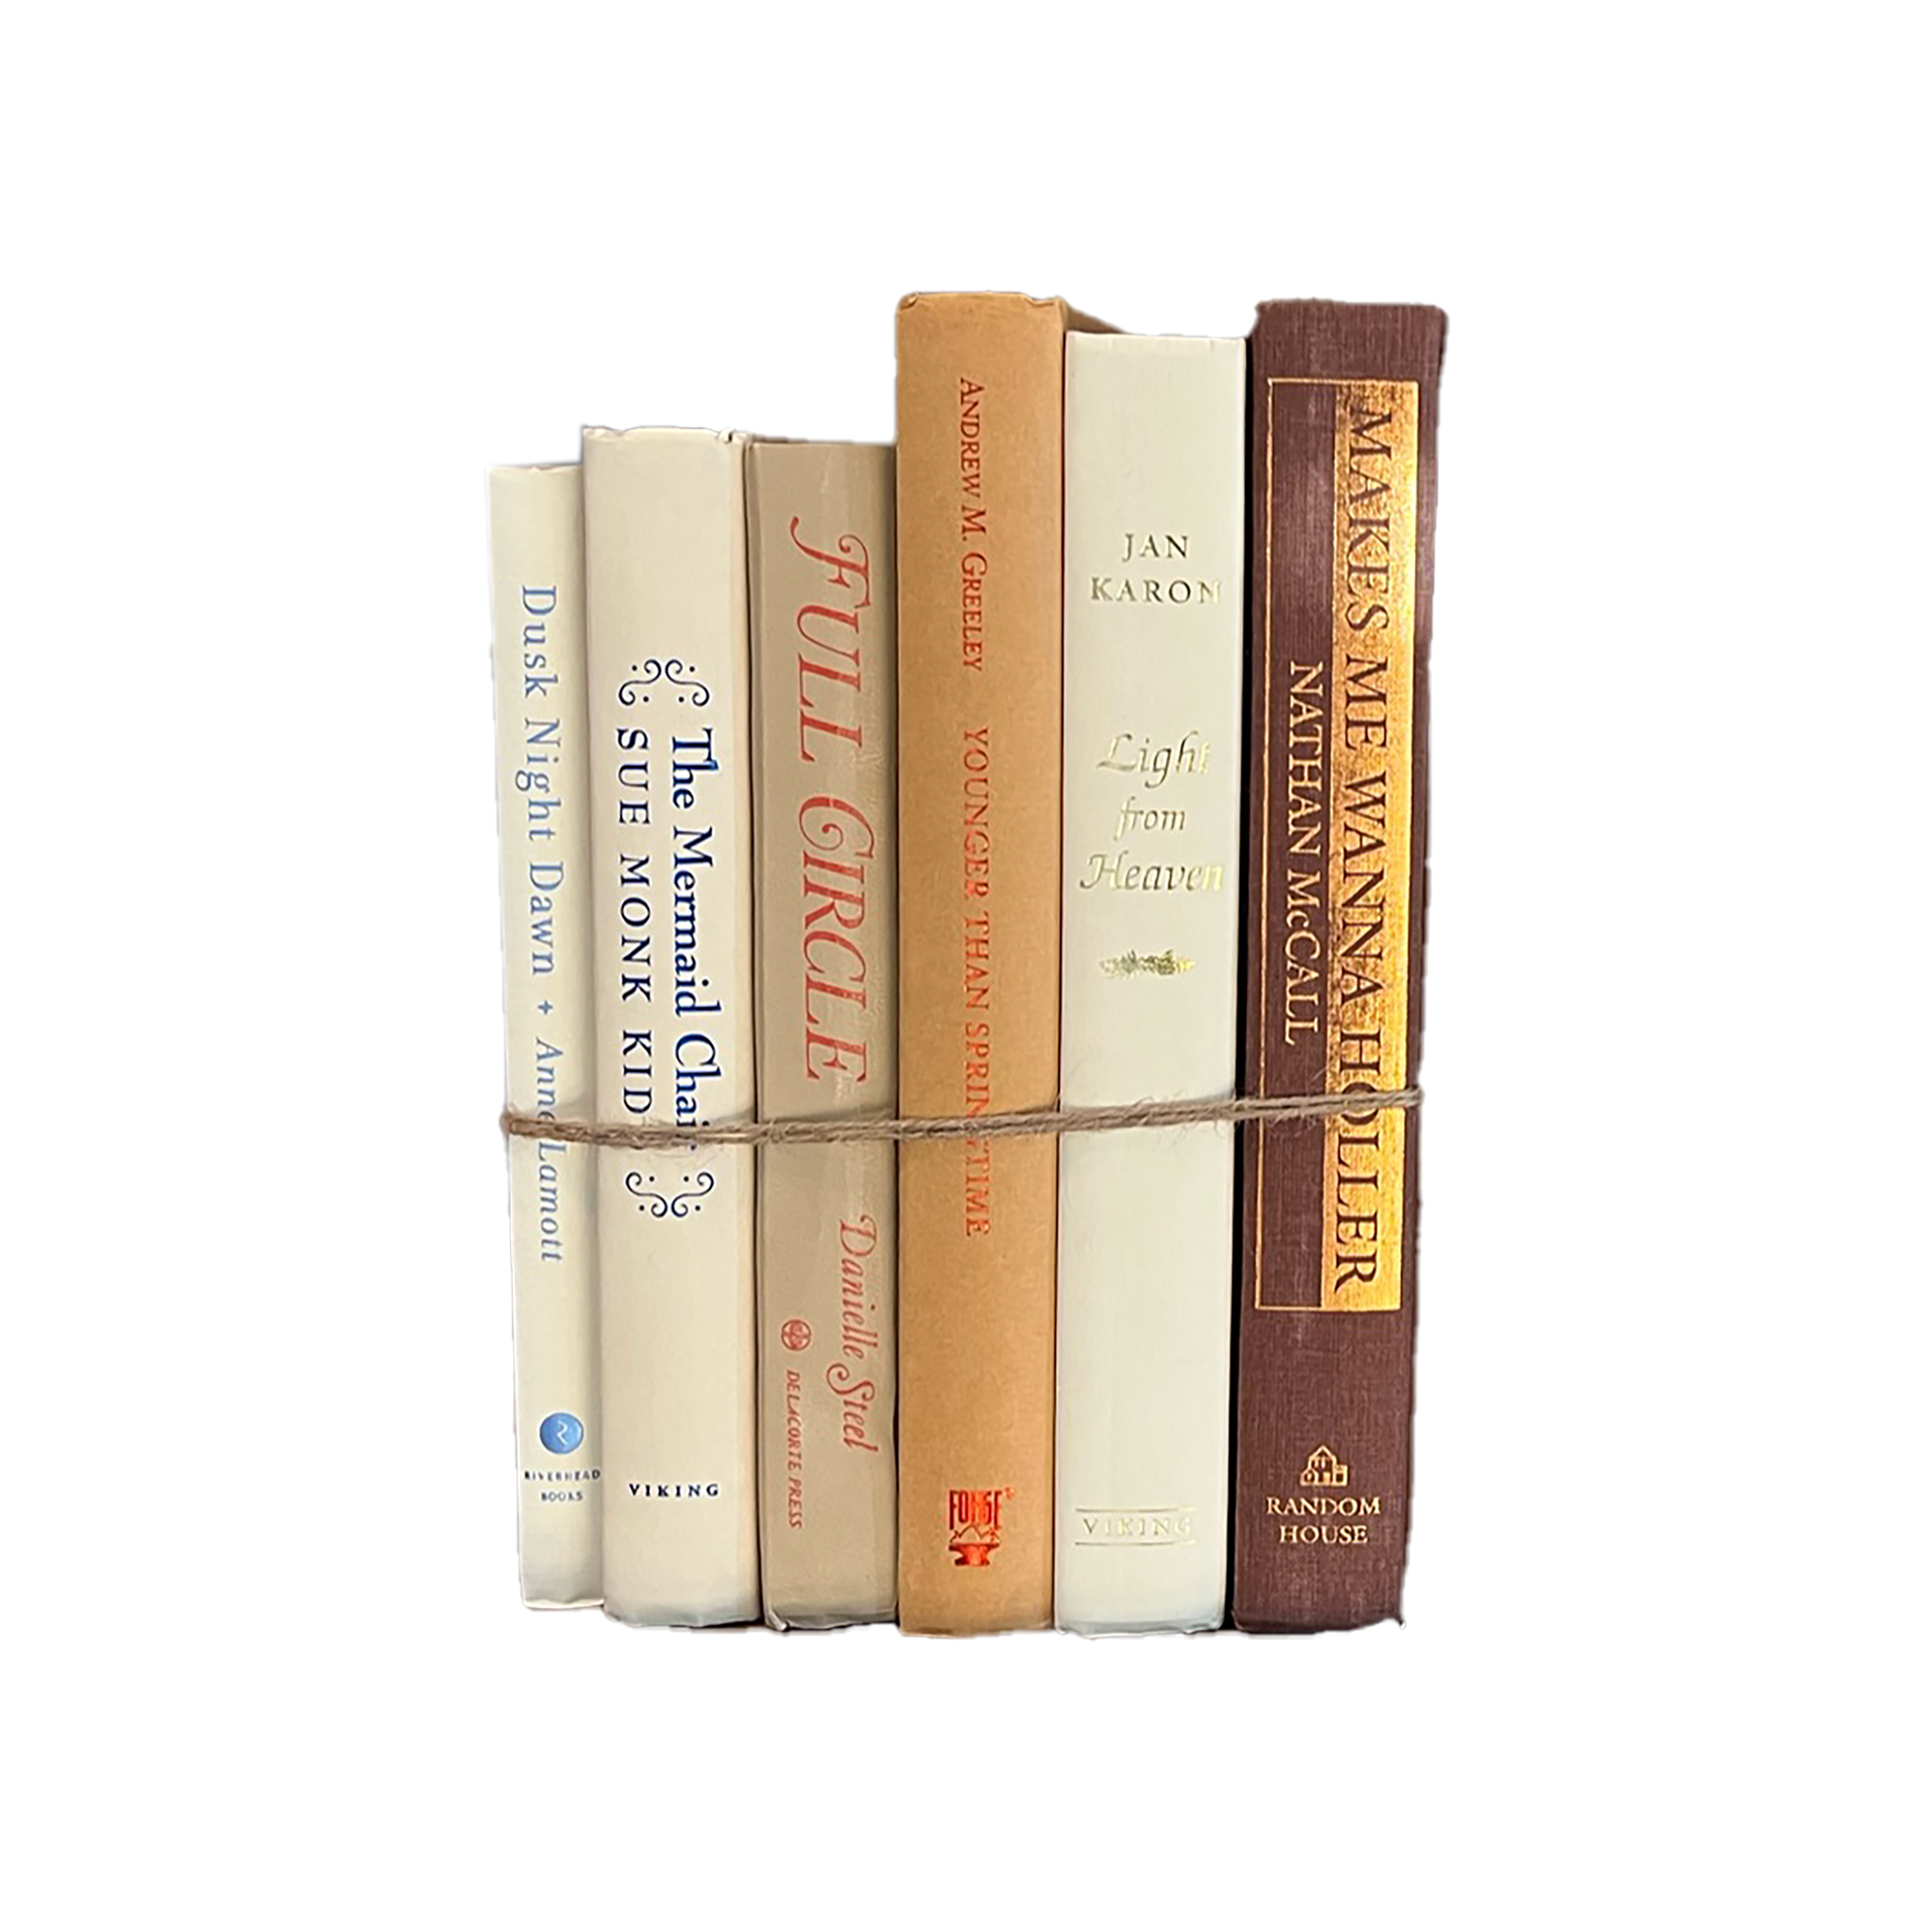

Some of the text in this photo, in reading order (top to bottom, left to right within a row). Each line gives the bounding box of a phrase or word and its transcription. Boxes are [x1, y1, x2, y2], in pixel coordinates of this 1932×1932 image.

[960, 378, 988, 671] ANDREW M. GREELEY
[1122, 533, 1190, 563] JAN
[1344, 407, 1393, 633] MAKES
[789, 516, 871, 763] FULL
[1091, 577, 1221, 605] KARON
[1344, 654, 1389, 752] ME
[515, 584, 564, 976] Dusk Night Dawn
[1097, 729, 1211, 788] Light
[1079, 850, 1225, 891] Heaven
[1115, 796, 1187, 841] from
[1284, 661, 1324, 1047] NATHAN McCALL
[616, 727, 653, 1150] SUE MONK KID
[671, 727, 723, 1151] The Mermaid Chai
[1340, 773, 1388, 1005] WANNA
[964, 725, 991, 1237] YOUNGER THAN SPRINTIME
[538, 1141, 566, 1263] Lamott
[826, 1213, 879, 1452] Danielle Steel
[524, 1468, 601, 1482] RIVERHEAD
[541, 1491, 583, 1502] BOOKS
[629, 1483, 719, 1497] VIKING
[786, 1367, 803, 1529] DELACORTE PRESS
[1083, 1518, 1192, 1536] VIKING
[1266, 1496, 1381, 1516] RANDOM
[1279, 1525, 1368, 1545] HOUSE
